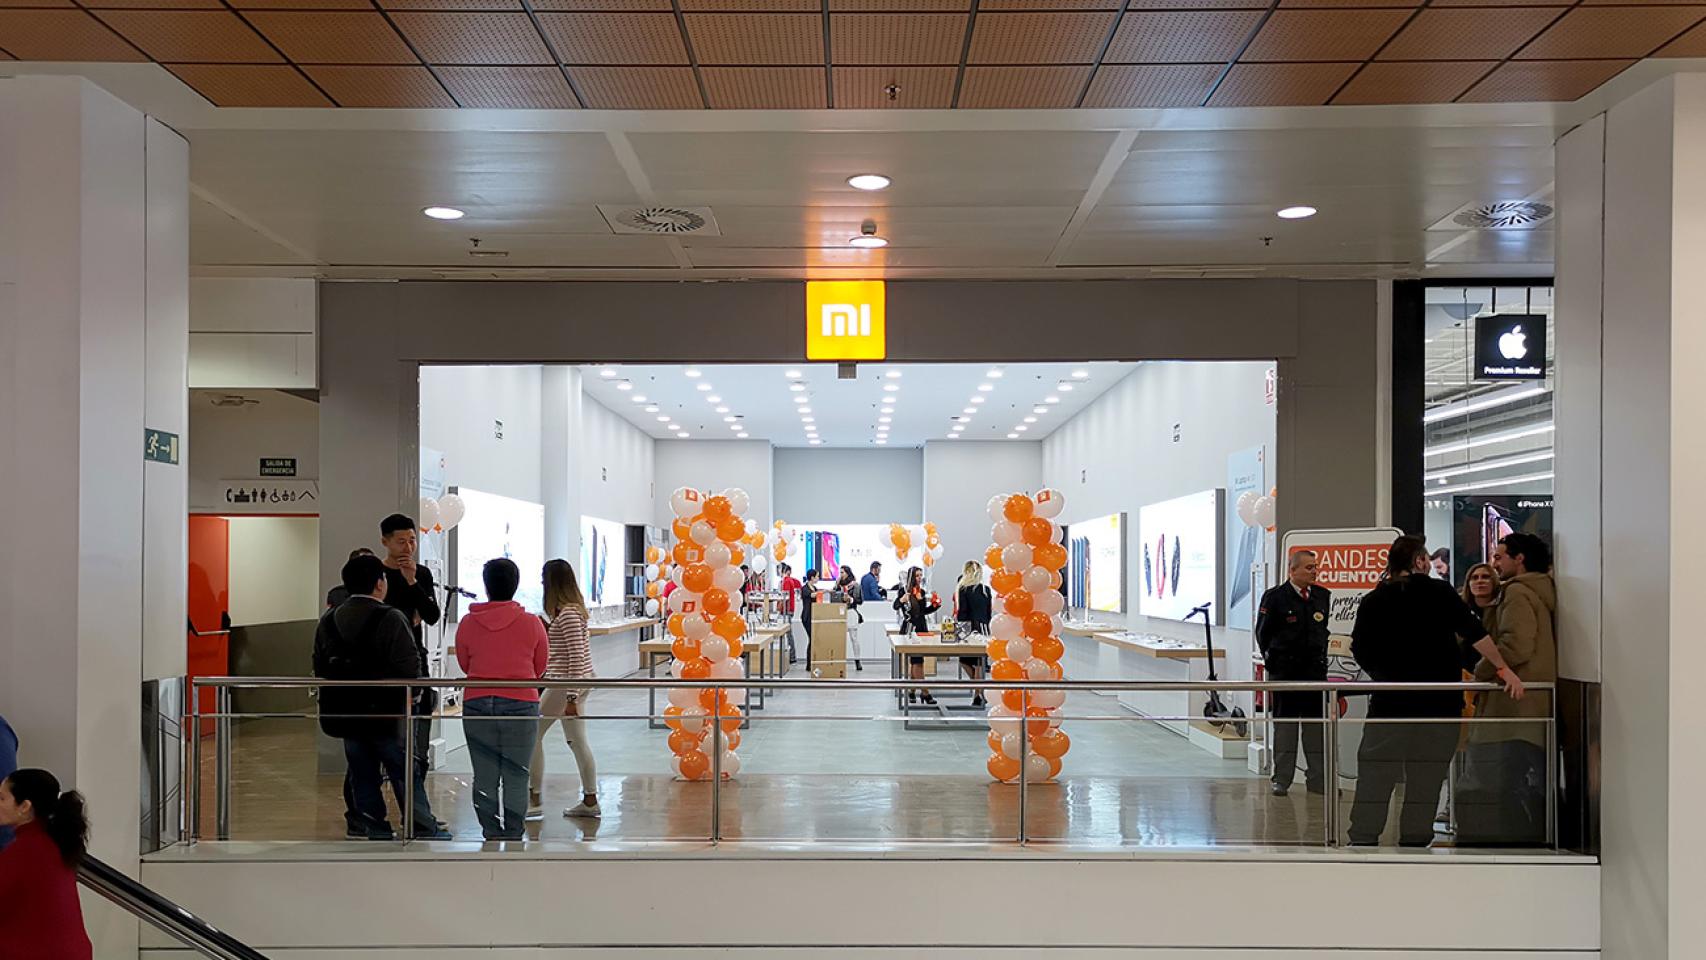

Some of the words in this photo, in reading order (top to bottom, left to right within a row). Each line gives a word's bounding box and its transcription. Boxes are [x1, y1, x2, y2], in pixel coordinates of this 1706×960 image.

[1484, 366, 1514, 375] Premium
[1515, 366, 1541, 375] Reseller
[265, 459, 283, 467] SALIDA
[284, 459, 292, 467] DE
[261, 467, 294, 475] EMERGENCIA
[1311, 549, 1390, 569] ANDES
[1316, 570, 1380, 584] CUENTO
